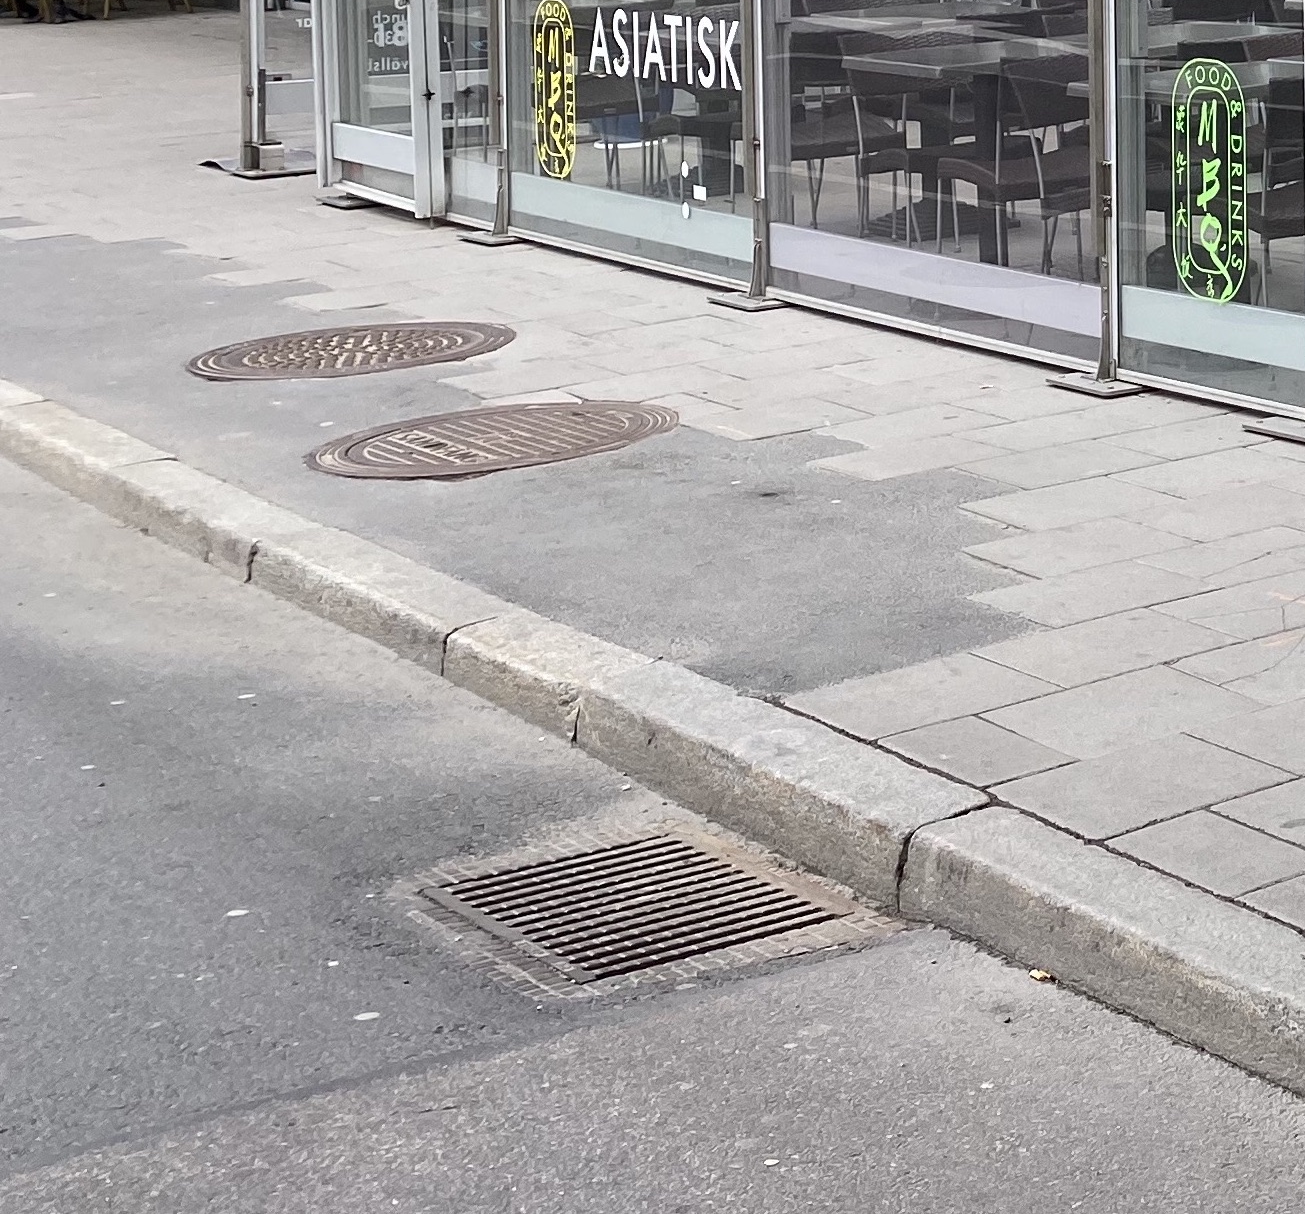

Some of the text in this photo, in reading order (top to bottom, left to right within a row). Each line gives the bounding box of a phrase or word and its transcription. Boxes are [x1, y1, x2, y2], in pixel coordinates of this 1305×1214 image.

[540, 2, 567, 22] FOOD
[588, 6, 743, 91] ASIATISK
[1184, 65, 1232, 91] FOOD
[1230, 135, 1244, 271] DRINKS
